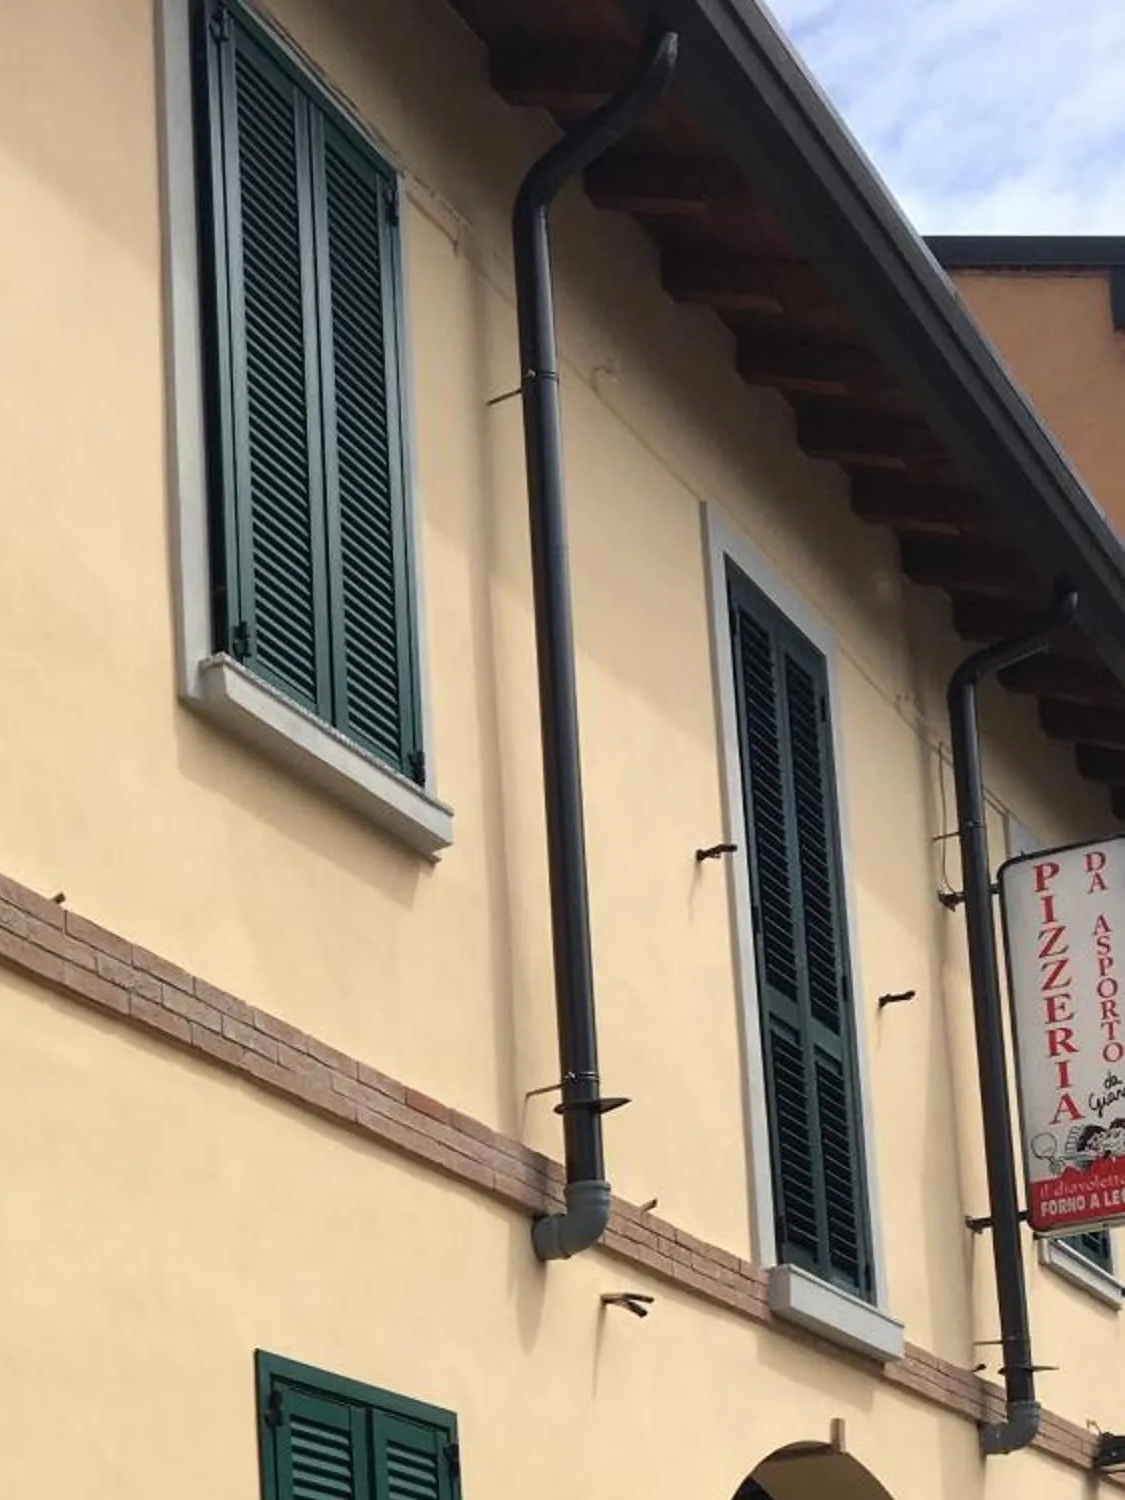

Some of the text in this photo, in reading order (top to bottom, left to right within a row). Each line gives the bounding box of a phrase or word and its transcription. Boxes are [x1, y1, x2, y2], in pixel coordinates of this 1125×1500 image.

[1033, 862, 1086, 1125] PIZZERIA
[1084, 851, 1124, 1063] DA ASPORTO
[1040, 1195, 1086, 1217] FORNO
[1089, 1191, 1101, 1209] A
